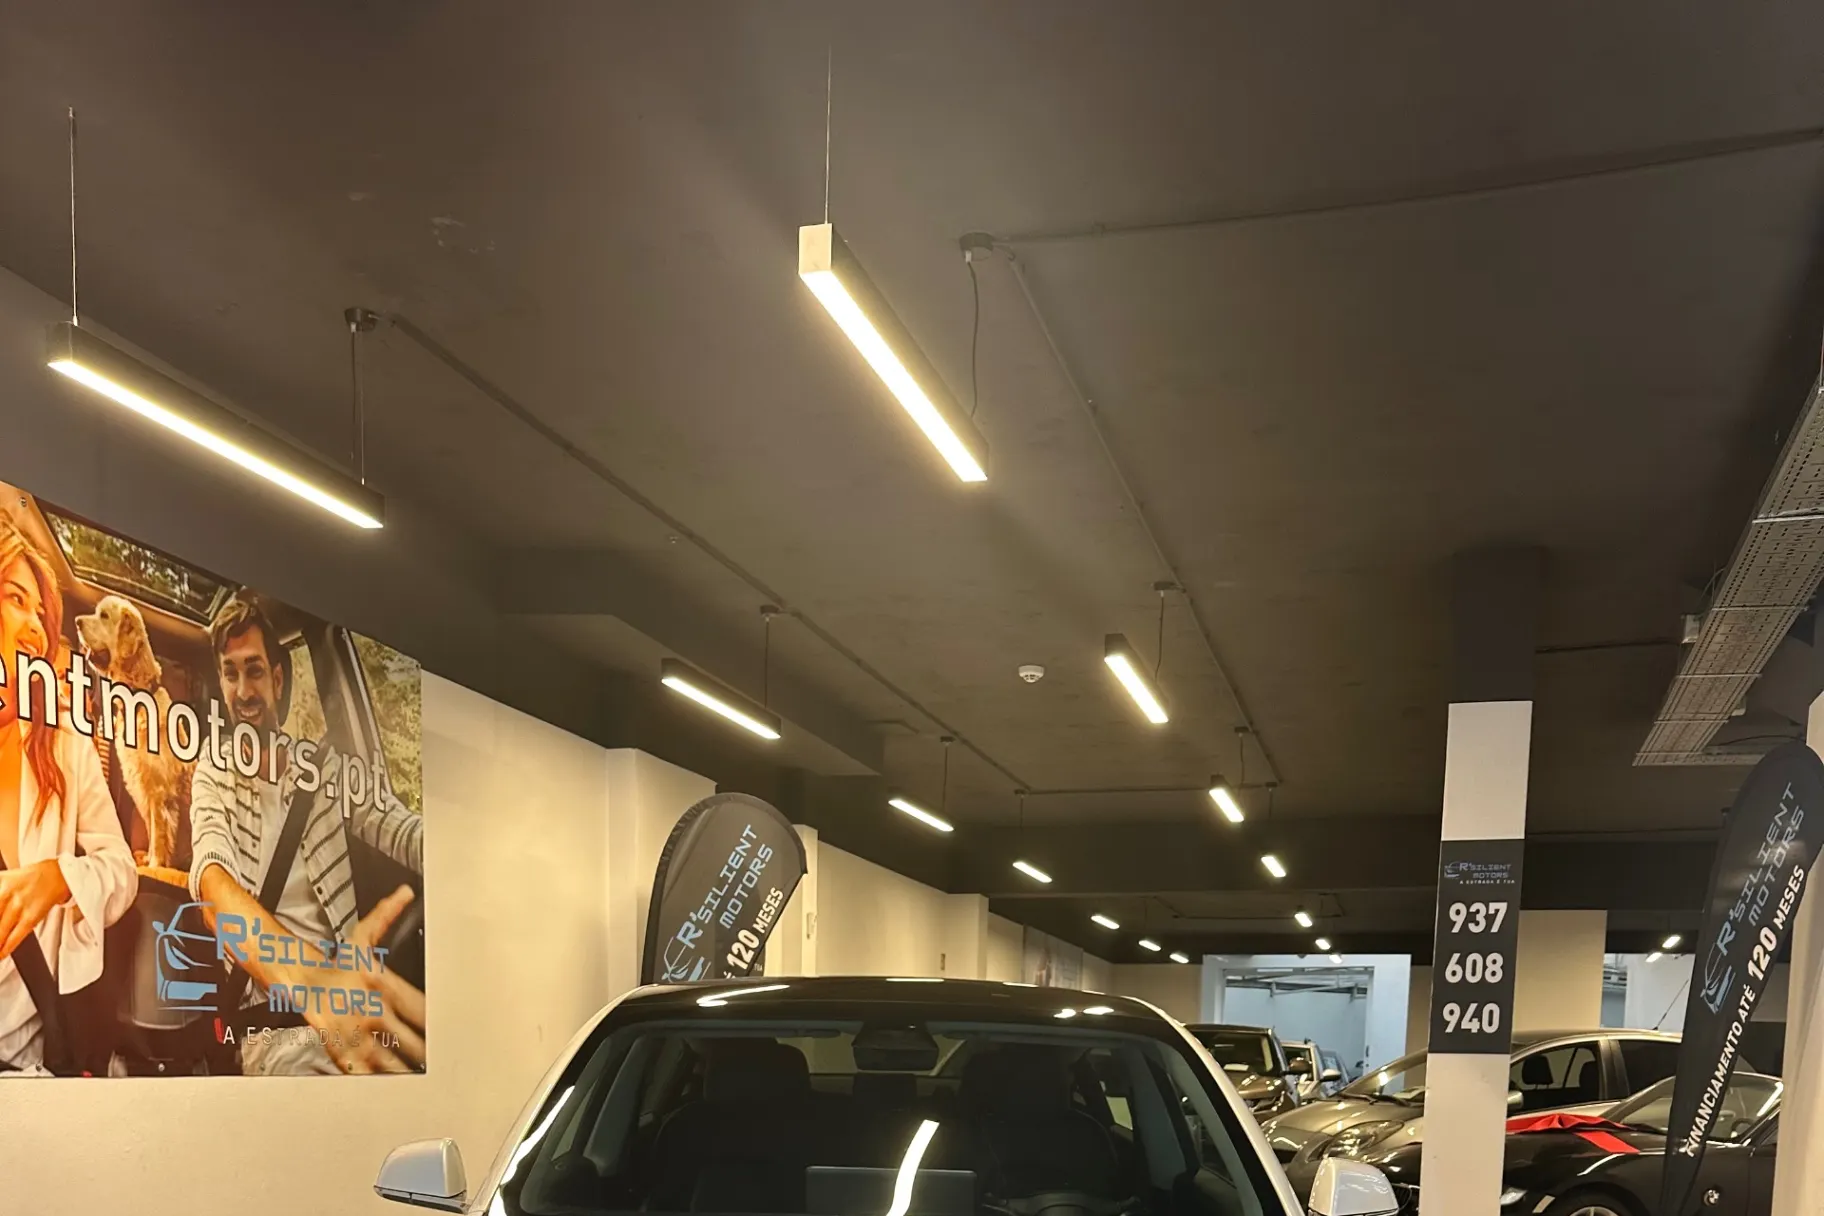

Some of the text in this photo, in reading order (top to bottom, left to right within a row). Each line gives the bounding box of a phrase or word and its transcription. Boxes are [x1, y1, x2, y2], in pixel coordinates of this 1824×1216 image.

[0, 650, 388, 818] ntmotors.pt
[676, 824, 757, 949] R'SILIENT
[719, 844, 773, 929] MOTORS
[1716, 782, 1795, 956] R'SILIENT
[1748, 805, 1804, 927] MOTORS
[216, 912, 389, 973] R'SILIENT
[727, 929, 760, 970] 120
[753, 887, 784, 934] MESES
[1448, 902, 1507, 933] 937
[1738, 984, 1756, 1023] ATÉ
[1747, 926, 1777, 980] 120
[1772, 865, 1804, 930] MESES
[269, 984, 384, 1017] MOTORS
[1445, 952, 1504, 983] 608
[223, 1026, 235, 1044] A
[247, 1026, 344, 1046] ESTRADA
[371, 1031, 400, 1048] TUA
[1442, 1002, 1501, 1033] 940
